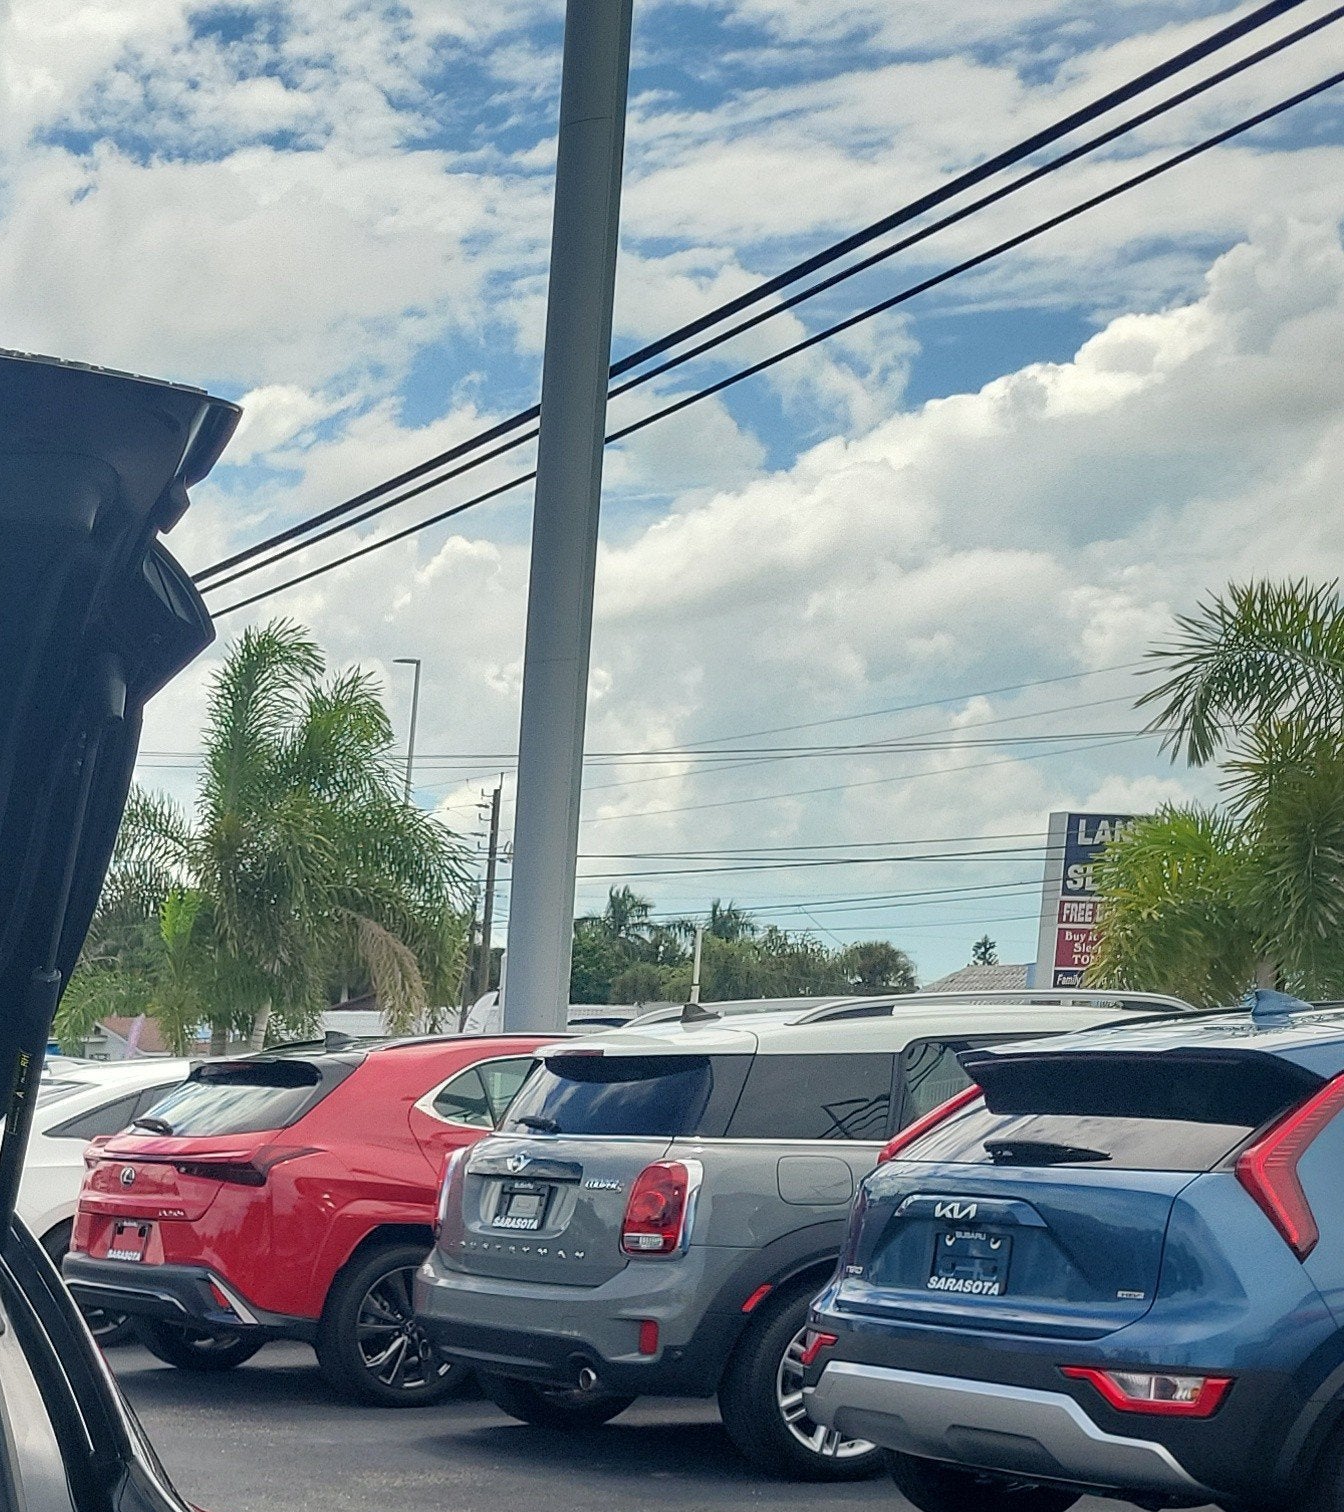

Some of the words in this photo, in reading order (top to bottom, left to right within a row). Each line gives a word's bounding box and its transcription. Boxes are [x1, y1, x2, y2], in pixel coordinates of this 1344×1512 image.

[1062, 902, 1094, 922] FREE
[1065, 931, 1086, 944] Buy
[492, 1215, 539, 1230] SARASOTA
[926, 1275, 1001, 1296] SARASOTA
